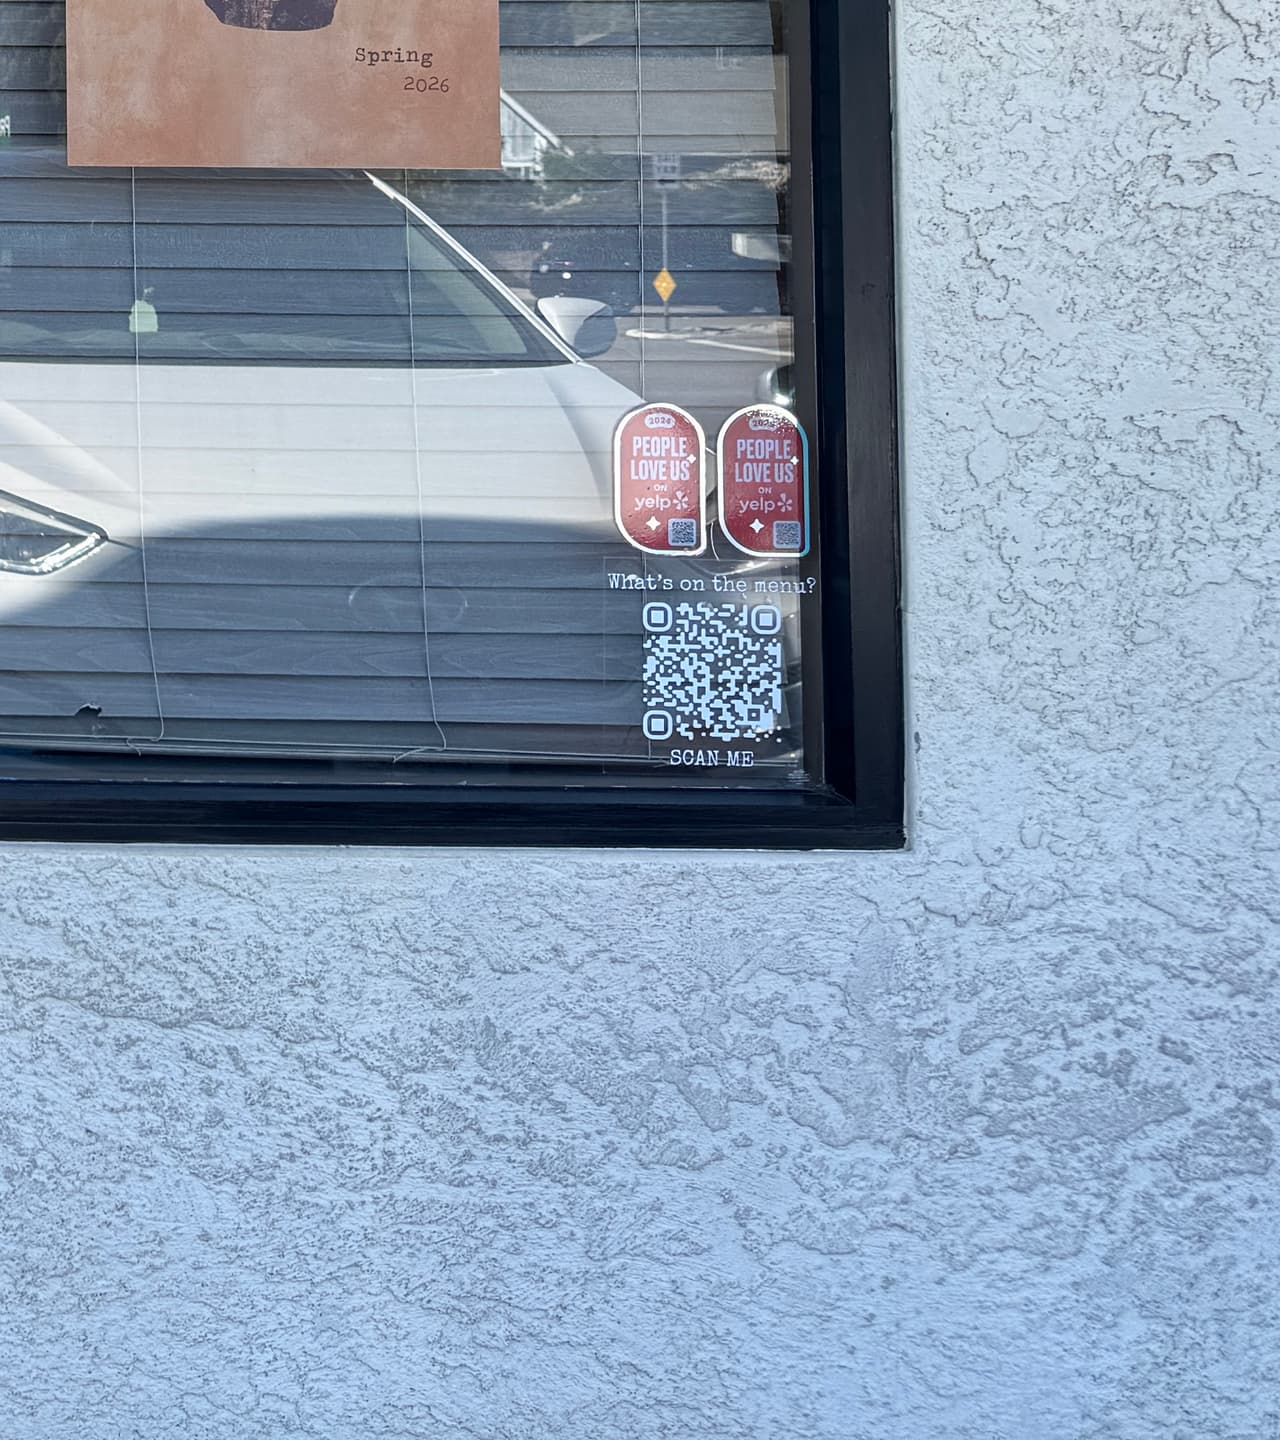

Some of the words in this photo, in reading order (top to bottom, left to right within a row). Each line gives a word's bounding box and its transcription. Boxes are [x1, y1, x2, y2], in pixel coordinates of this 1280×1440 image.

[355, 46, 433, 68] Spring
[404, 75, 450, 94] 2026
[632, 436, 688, 458] PEOPLE
[736, 439, 791, 460] PEOPLE
[630, 459, 667, 481] LOVE
[669, 461, 690, 481] US
[735, 462, 772, 484] LOVE
[774, 462, 794, 484] US
[654, 484, 668, 492] ON
[758, 486, 772, 495] ON
[634, 494, 671, 511] yelp
[739, 496, 776, 513] yelp
[607, 572, 673, 591] What's
[681, 578, 706, 591] on
[712, 575, 747, 592] the
[754, 576, 818, 595] menu?
[670, 750, 721, 766] SCAN
[727, 751, 754, 767] ME
